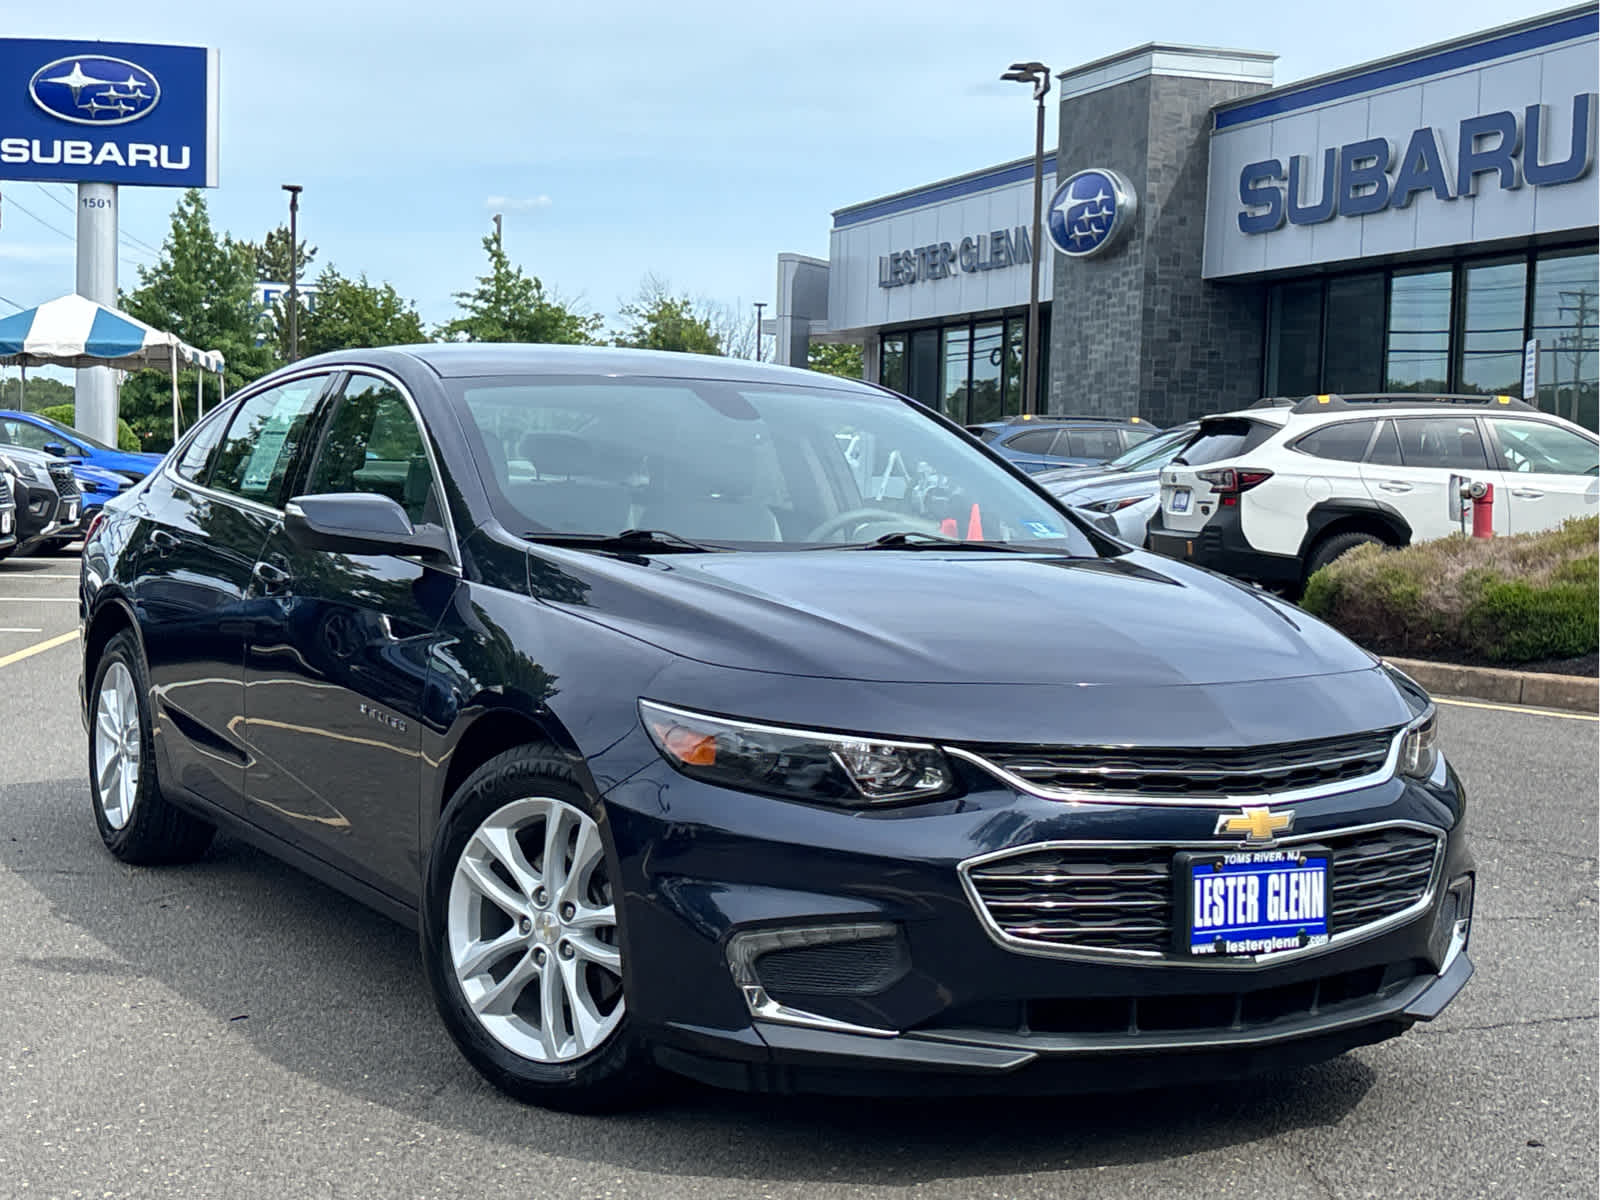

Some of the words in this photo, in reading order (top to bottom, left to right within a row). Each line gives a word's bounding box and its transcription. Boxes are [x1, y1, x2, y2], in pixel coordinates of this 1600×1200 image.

[0, 138, 191, 170] SUBARU
[1238, 93, 1598, 235] SUBARU
[82, 198, 112, 209] 1501
[879, 241, 958, 288] LESTER
[1224, 852, 1251, 865] TOMS
[1253, 850, 1285, 863] RIVER,
[1286, 850, 1300, 861] NJ
[1194, 875, 1260, 928] LESTER
[1267, 871, 1324, 922] GLENN
